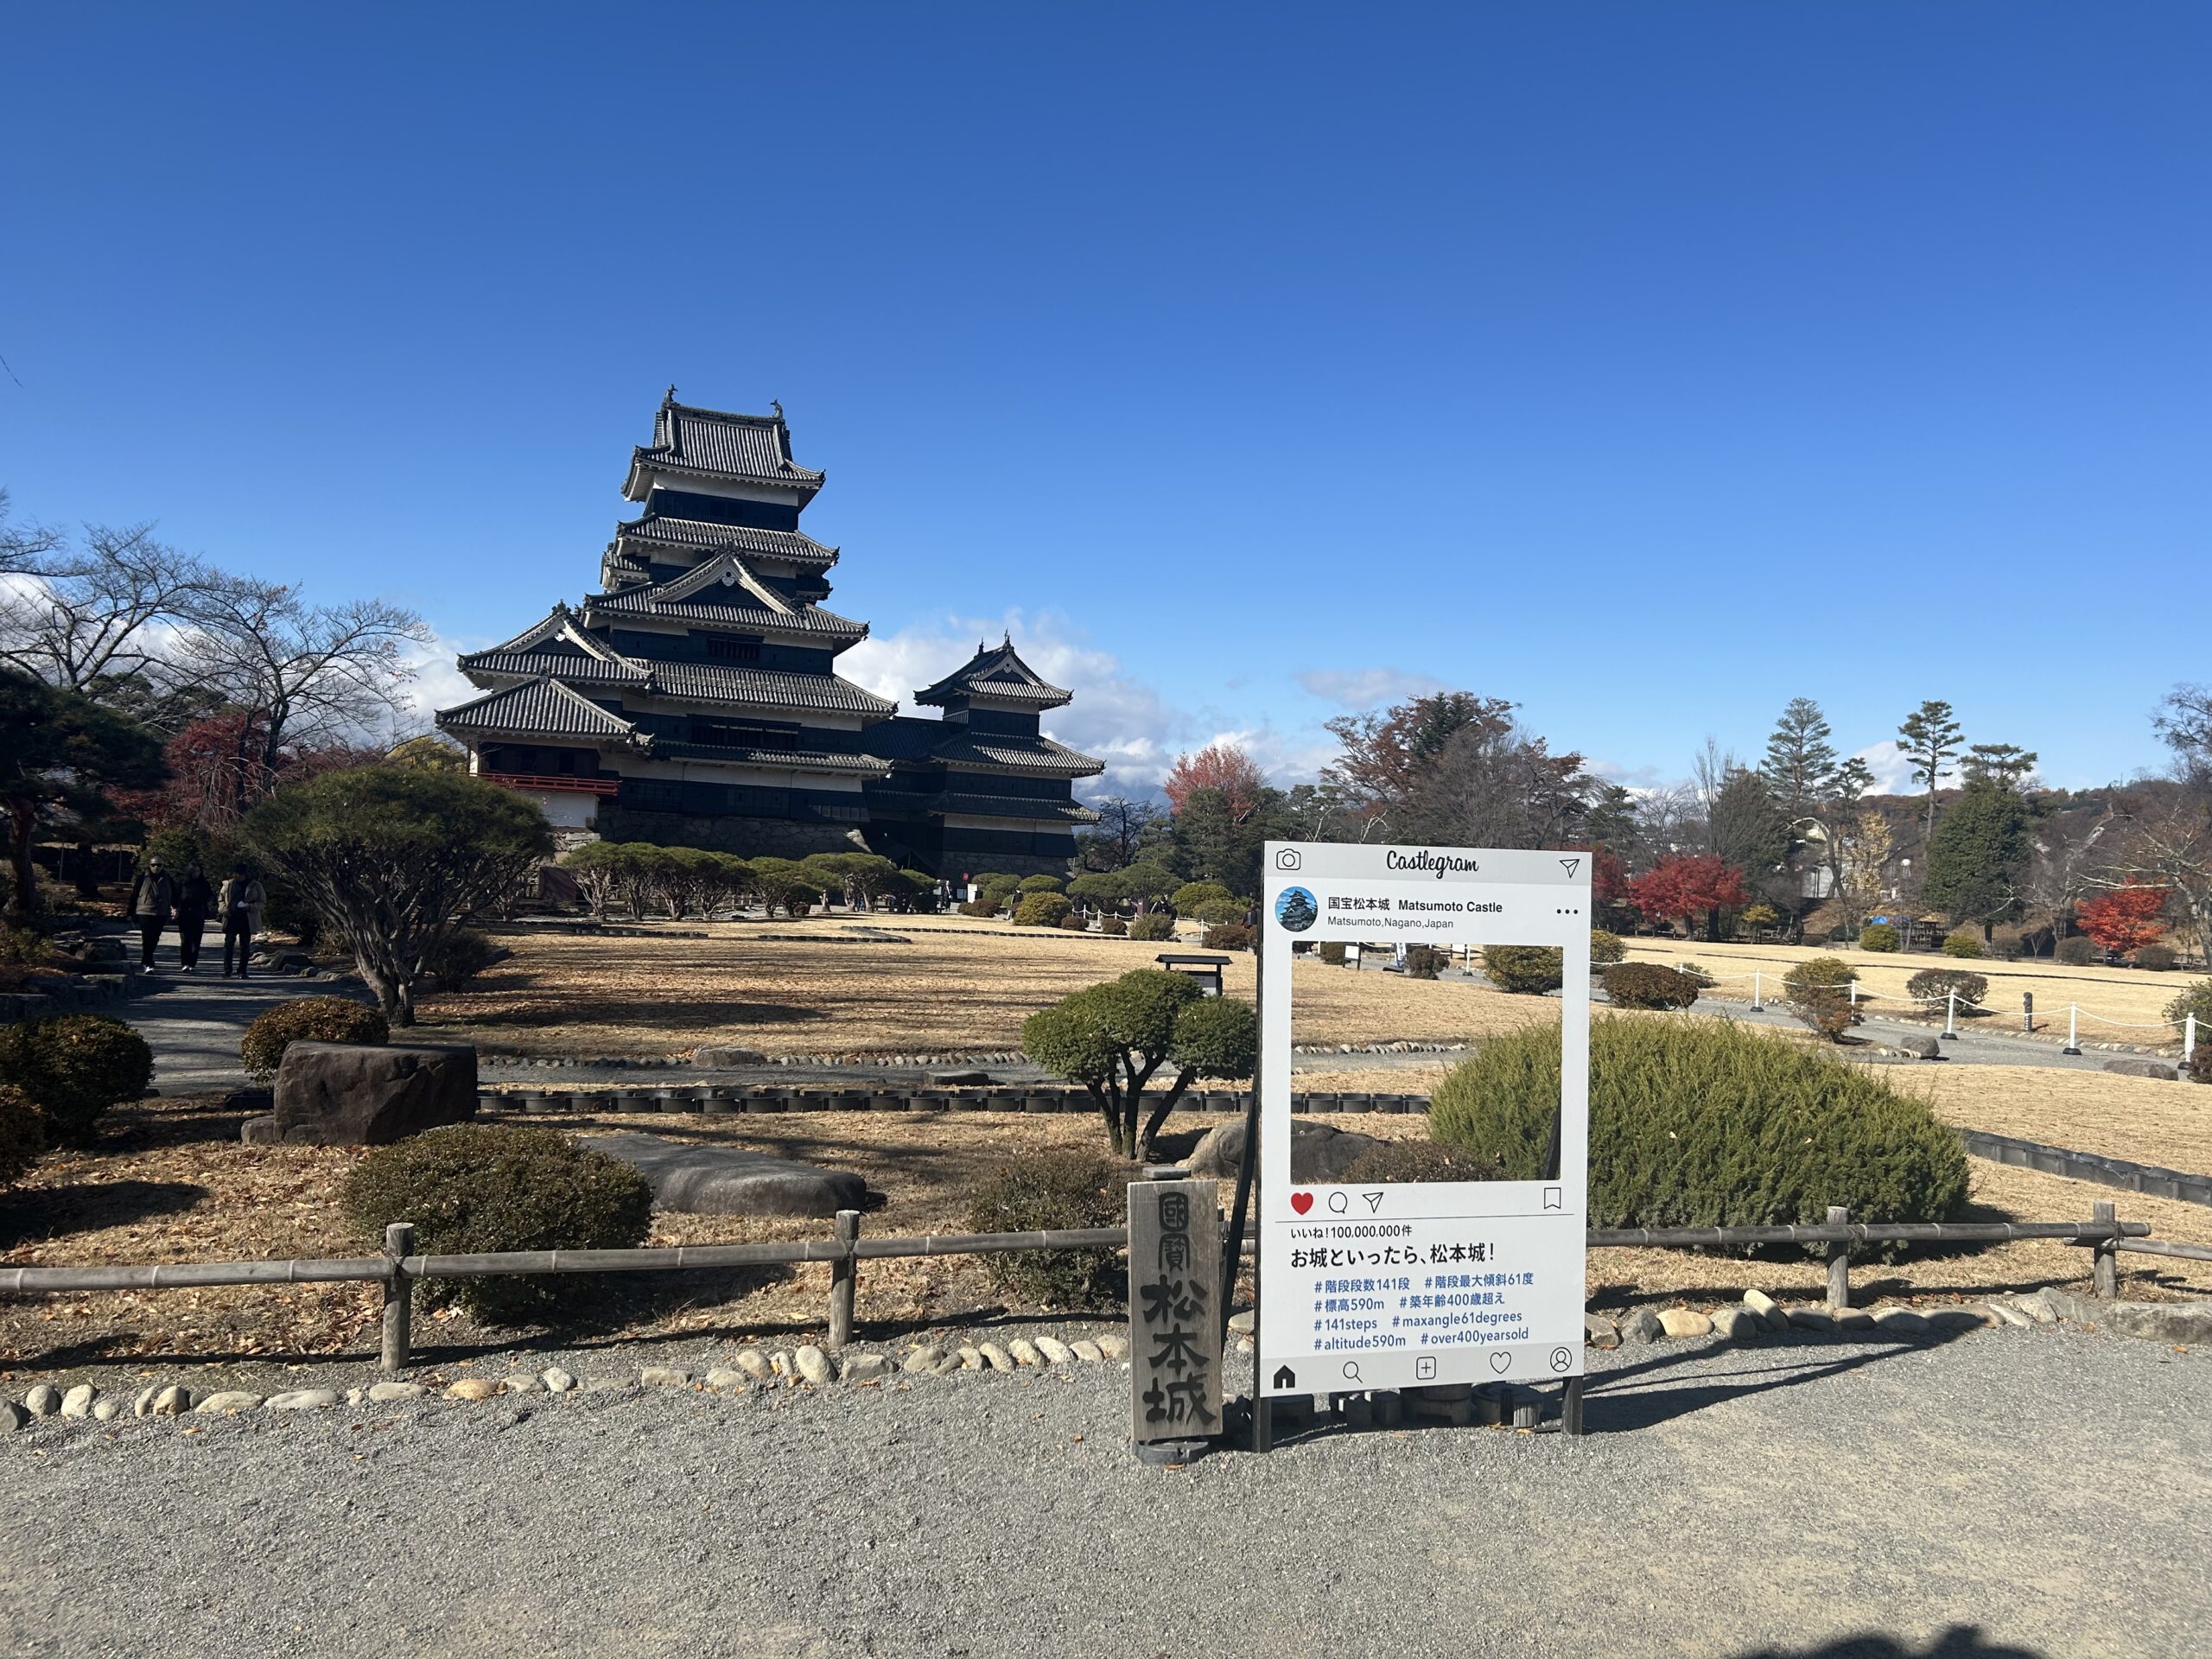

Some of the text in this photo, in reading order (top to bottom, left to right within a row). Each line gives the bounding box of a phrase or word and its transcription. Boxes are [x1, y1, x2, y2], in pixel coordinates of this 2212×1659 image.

[1386, 849, 1479, 879] Castlegram
[1328, 896, 1503, 912] 国宝松本城 Matsumoto Castle
